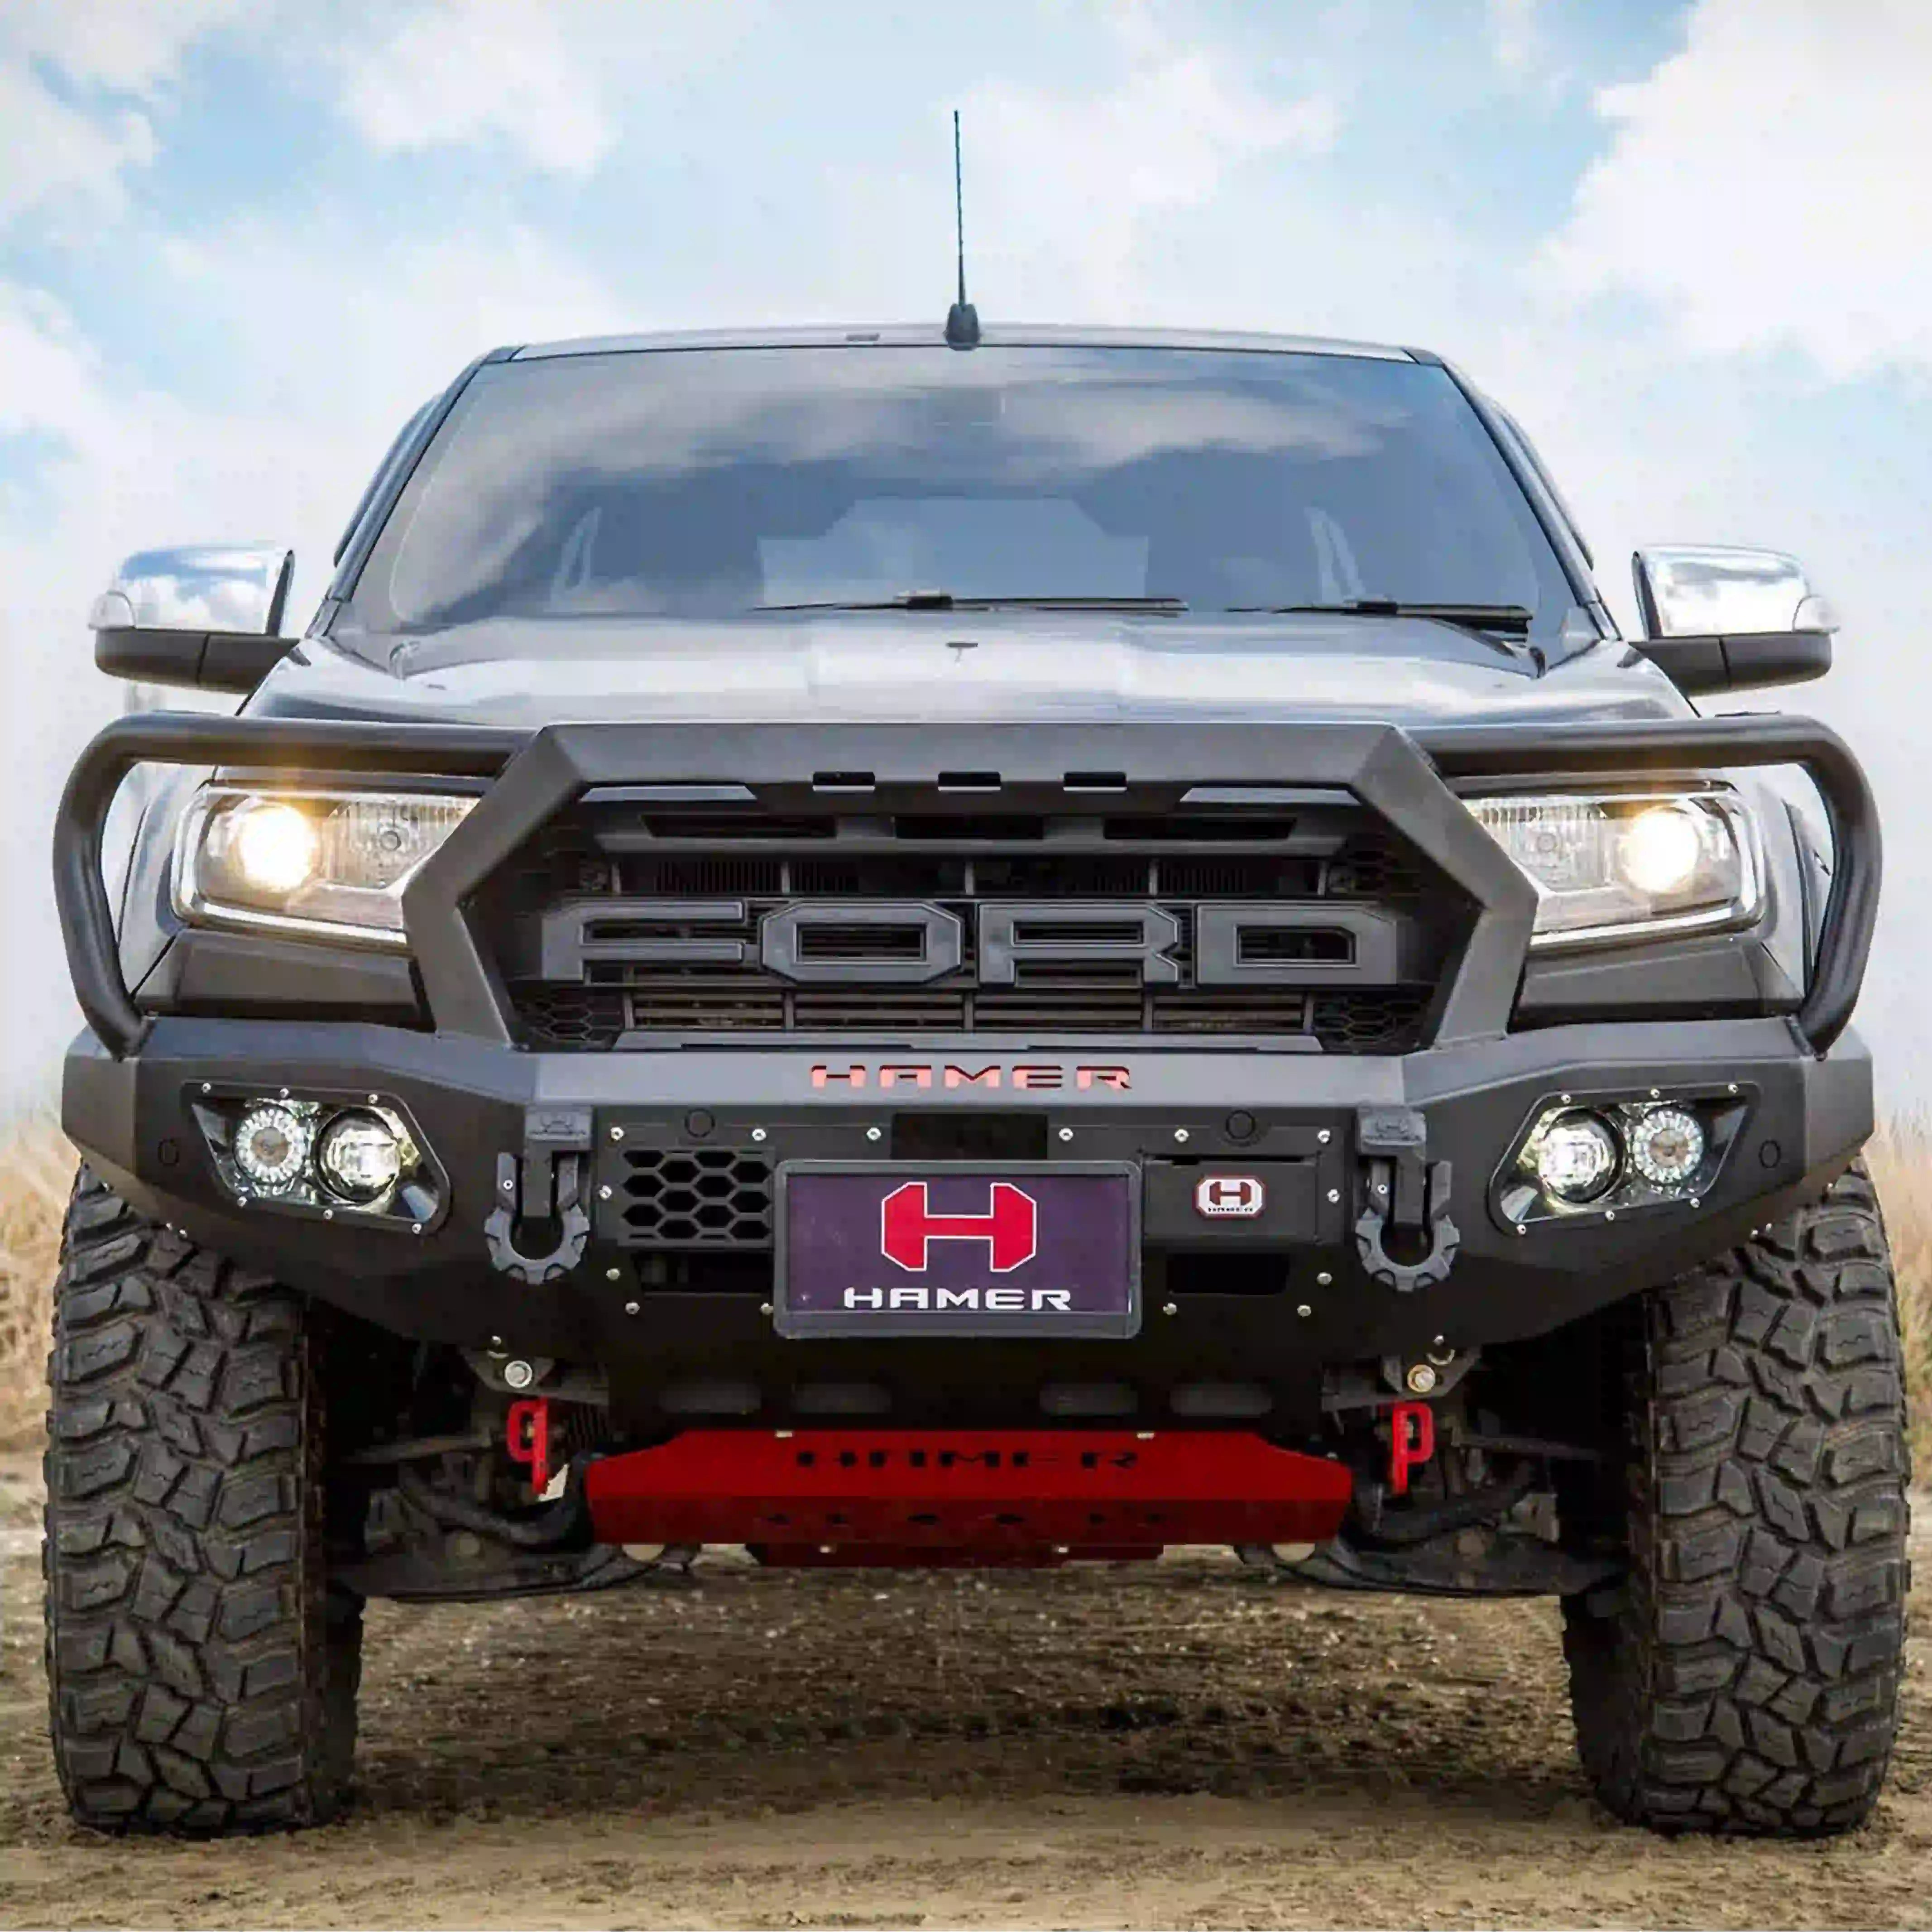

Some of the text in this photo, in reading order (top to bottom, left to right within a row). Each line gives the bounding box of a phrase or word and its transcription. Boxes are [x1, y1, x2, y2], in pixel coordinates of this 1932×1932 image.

[542, 900, 1397, 985] FORD
[811, 1064, 1132, 1089] HAMER
[843, 1287, 1071, 1311] HAMER
